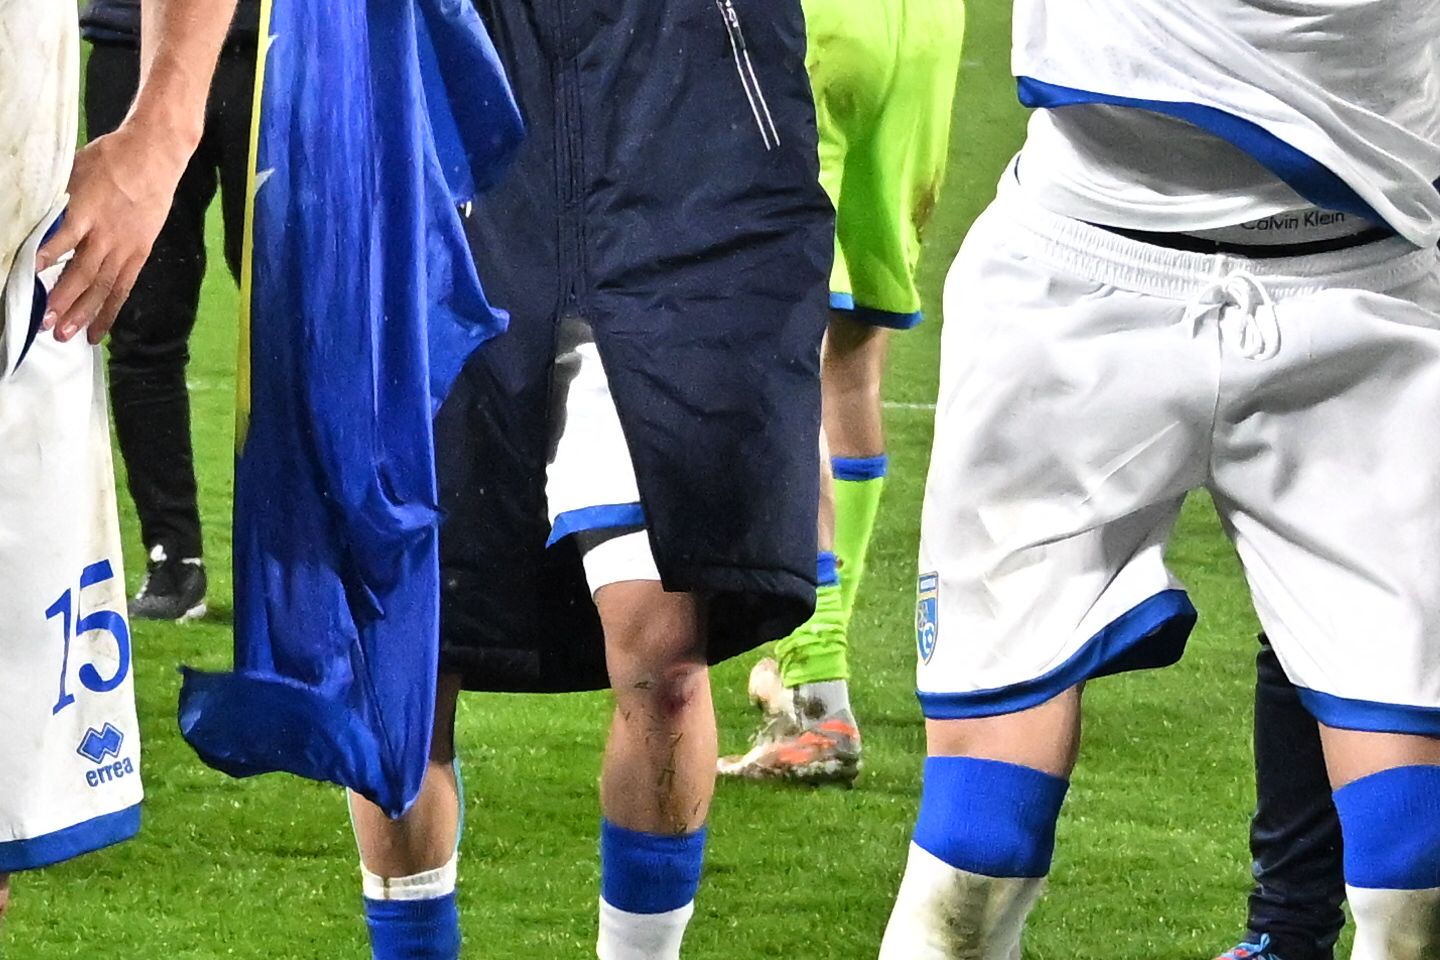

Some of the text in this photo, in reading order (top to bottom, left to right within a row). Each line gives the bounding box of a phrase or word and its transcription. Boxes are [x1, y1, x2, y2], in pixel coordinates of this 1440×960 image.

[1240, 210, 1345, 231] Calvin Klein
[45, 558, 131, 716] 15
[85, 756, 135, 788] errea
